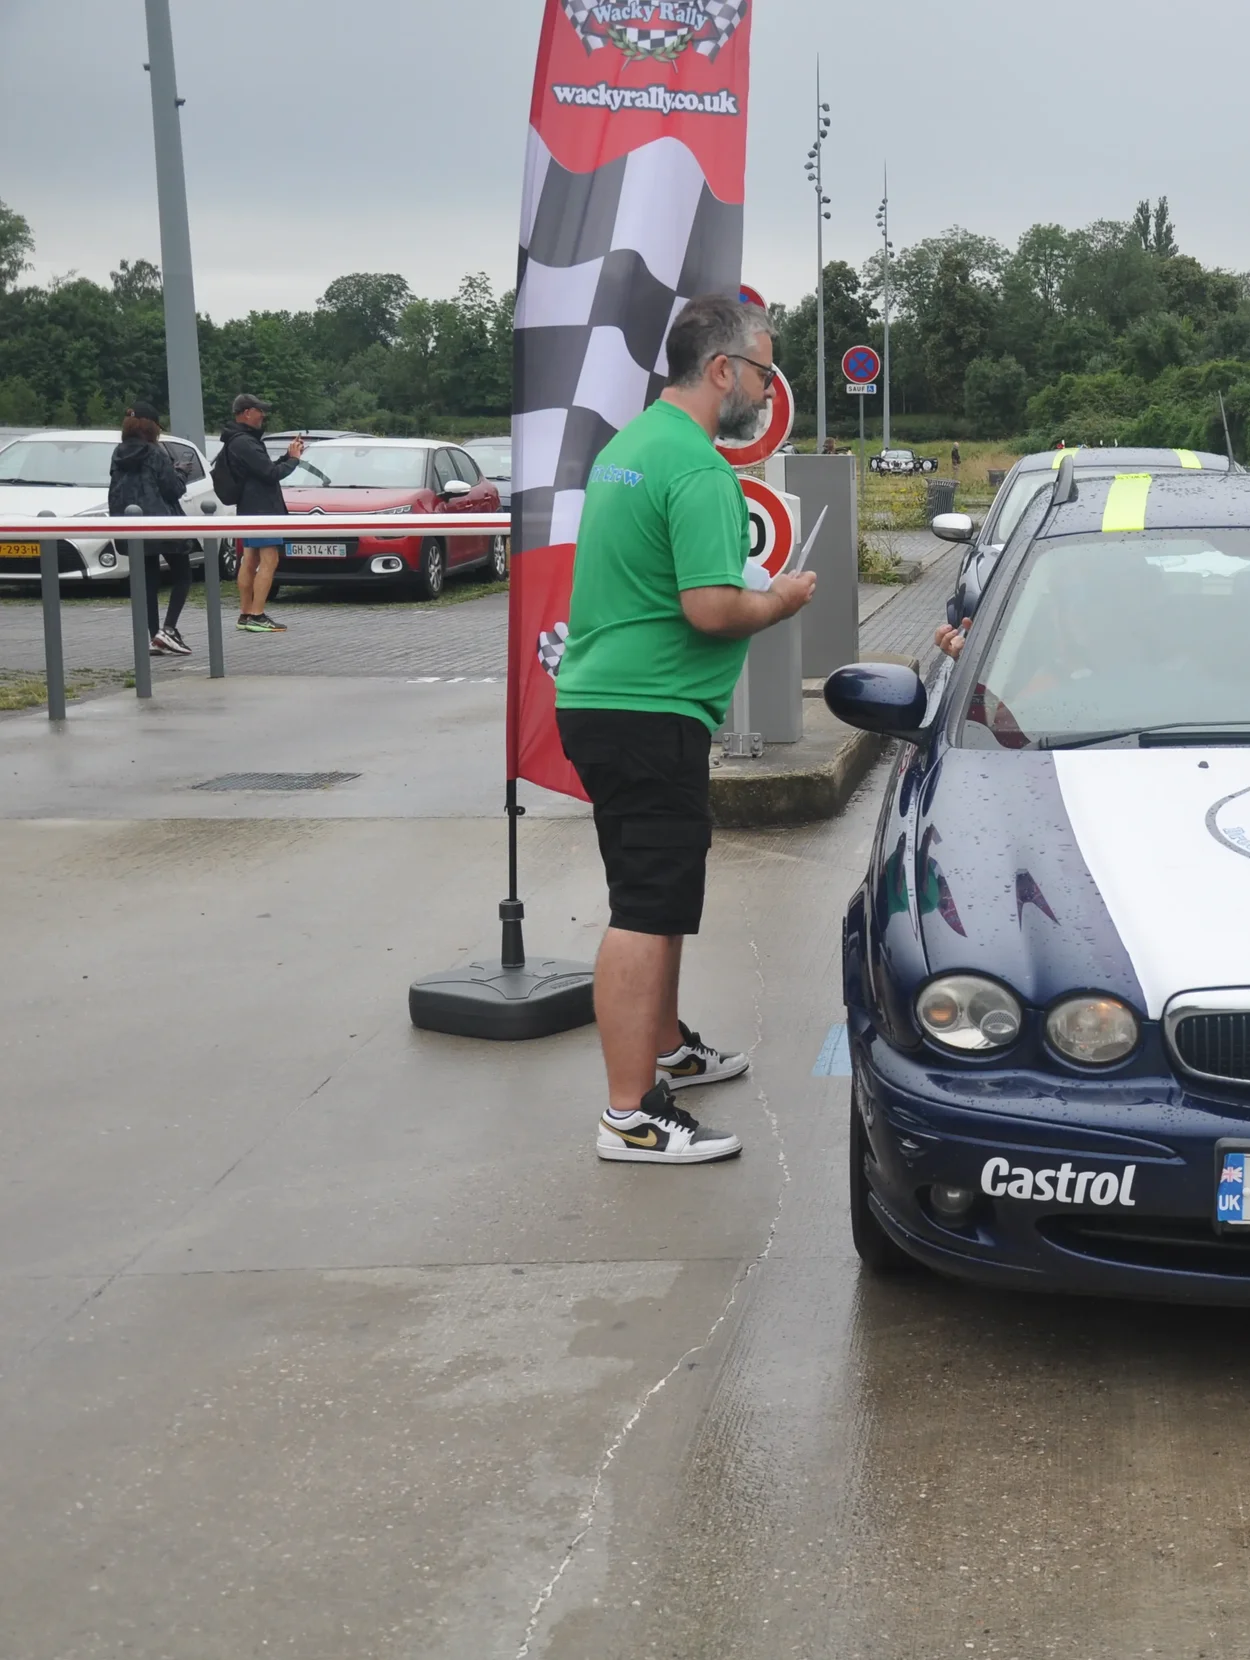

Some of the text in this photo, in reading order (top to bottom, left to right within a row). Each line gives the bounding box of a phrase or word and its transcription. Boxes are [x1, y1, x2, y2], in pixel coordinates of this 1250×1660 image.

[592, 0, 708, 30] Wacky Rally
[552, 83, 738, 114] wackyrally.co.uk
[848, 385, 866, 393] SAUF
[0, 545, 38, 554] -293-H
[980, 1156, 1137, 1206] Castrol
[1218, 1194, 1241, 1212] UK
